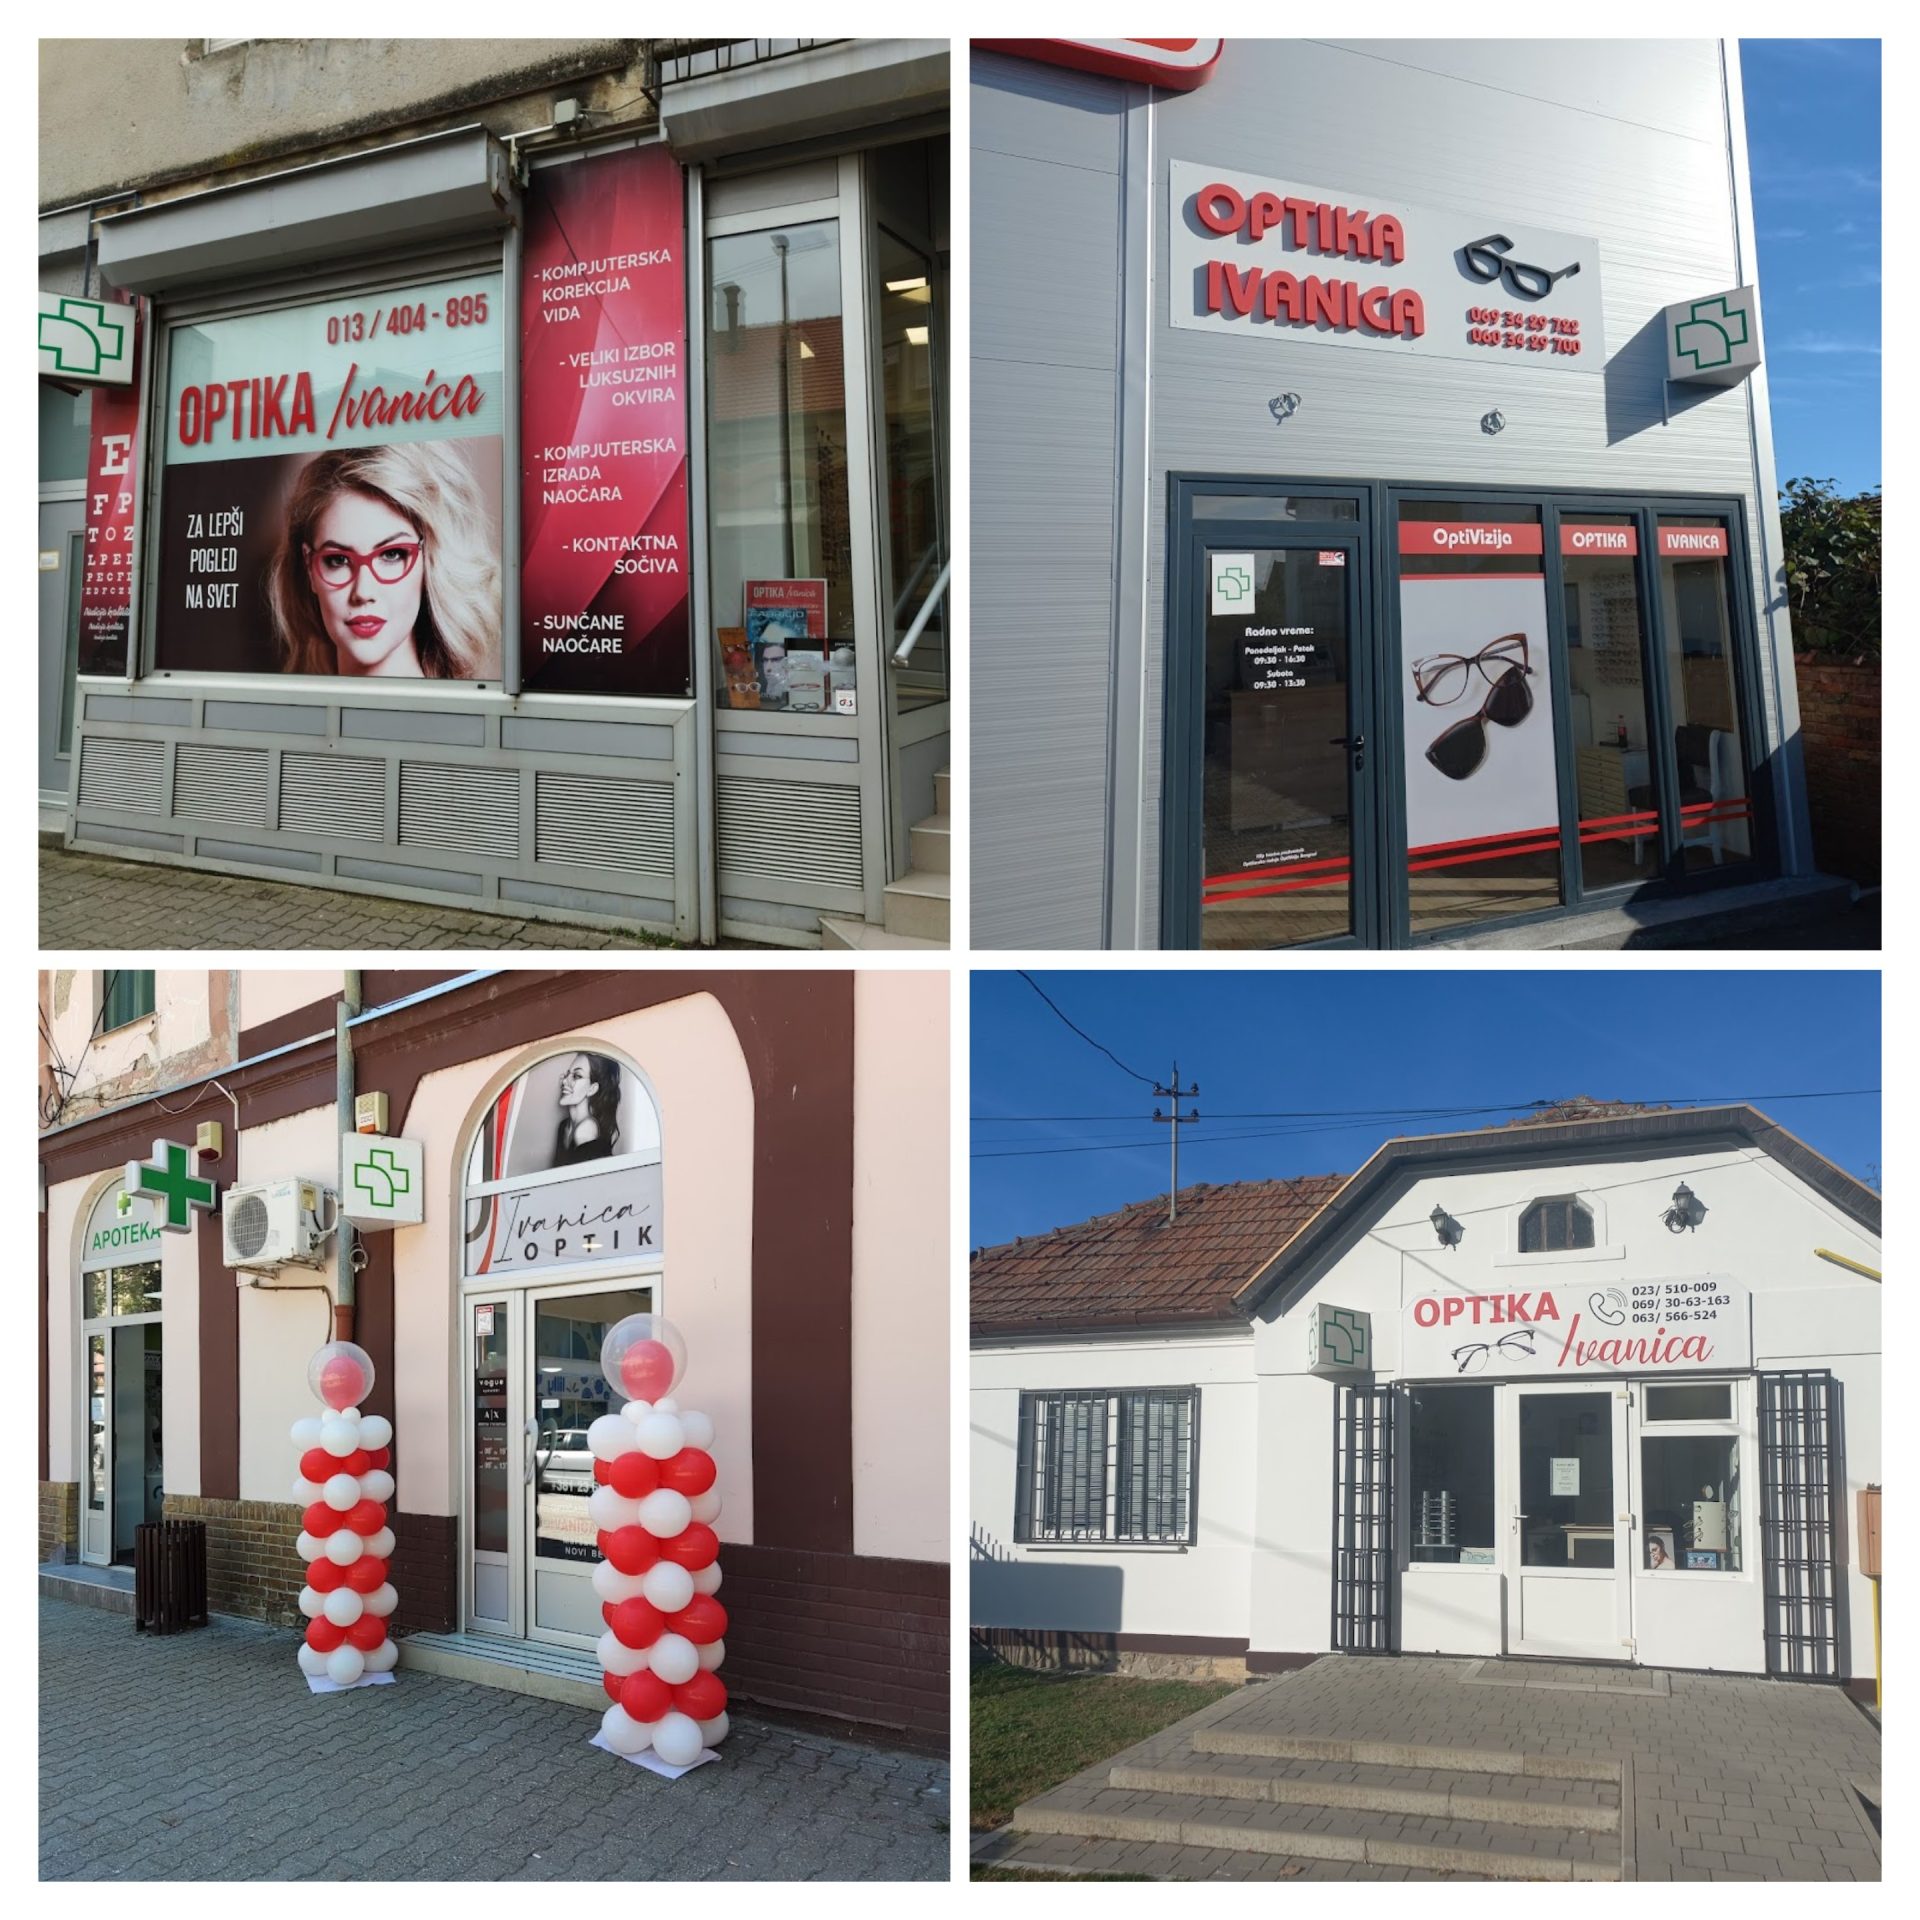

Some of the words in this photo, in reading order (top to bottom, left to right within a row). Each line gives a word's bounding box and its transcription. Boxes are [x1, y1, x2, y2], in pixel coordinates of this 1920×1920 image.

[1197, 183, 1404, 263] OPTIKA
[542, 249, 672, 282] KOMPJUTERSKA
[542, 277, 630, 302] KOREKCIJA
[1207, 260, 1425, 336] IVANICA
[327, 312, 364, 345] 013
[368, 310, 381, 339] /
[386, 303, 426, 335] 404
[446, 293, 488, 328] 895
[543, 305, 580, 323] VIDA
[1470, 307, 1500, 326] 069
[1504, 311, 1524, 328] 34
[1528, 314, 1548, 332] 29
[1551, 317, 1580, 336] 722
[1471, 327, 1501, 347] 060
[1505, 332, 1525, 349] 34
[1529, 335, 1549, 352] 29
[1552, 338, 1581, 356] 700
[569, 349, 620, 368] VELIKI
[624, 342, 676, 362] IZBOR
[579, 364, 676, 388] LUKSUZNIH
[179, 371, 316, 447] OPTIKA
[326, 362, 486, 440] Ivanica
[611, 387, 676, 407] OKVIRA
[100, 434, 131, 476] E
[544, 438, 677, 462] KOMPJUTERSKA
[543, 466, 602, 483] IZRADA
[543, 484, 623, 504] NAOČARA
[186, 514, 203, 538] ZA
[209, 506, 244, 537] LEPŠI
[572, 535, 678, 553] KONTAKTNA
[1433, 527, 1512, 549] OptiVizija
[1572, 531, 1627, 548] OPTIKA
[1667, 533, 1719, 549] IVANICA
[190, 548, 237, 573] POGLED
[614, 555, 679, 574] SOČIVA
[185, 584, 203, 609] NA
[207, 584, 239, 608] SVET
[753, 586, 784, 598] OPTIKA
[543, 612, 624, 631] SUNČANE
[1245, 627, 1277, 637] Radno
[1280, 627, 1314, 636] vreme:
[542, 634, 623, 654] NAOČARE
[1244, 646, 1287, 656] Ponedeljak
[1254, 656, 1277, 665] 09:30
[1284, 655, 1306, 664] 16:30
[1266, 670, 1293, 678] Subota
[1254, 681, 1277, 690] 09:30
[1284, 679, 1306, 688] 13:30
[494, 1194, 650, 1263] Ivanica
[1413, 1291, 1560, 1328] OPTIKA
[1632, 1284, 1661, 1297] 023/
[1665, 1282, 1717, 1294] 510-009
[1632, 1299, 1661, 1310] 069/
[1665, 1295, 1730, 1308] 30-63-163
[1632, 1312, 1661, 1324] 063/
[1665, 1310, 1717, 1322] 566-524
[1557, 1313, 1714, 1367] Ivanica
[479, 1379, 504, 1387] vogue
[565, 1546, 587, 1557] NOVI
